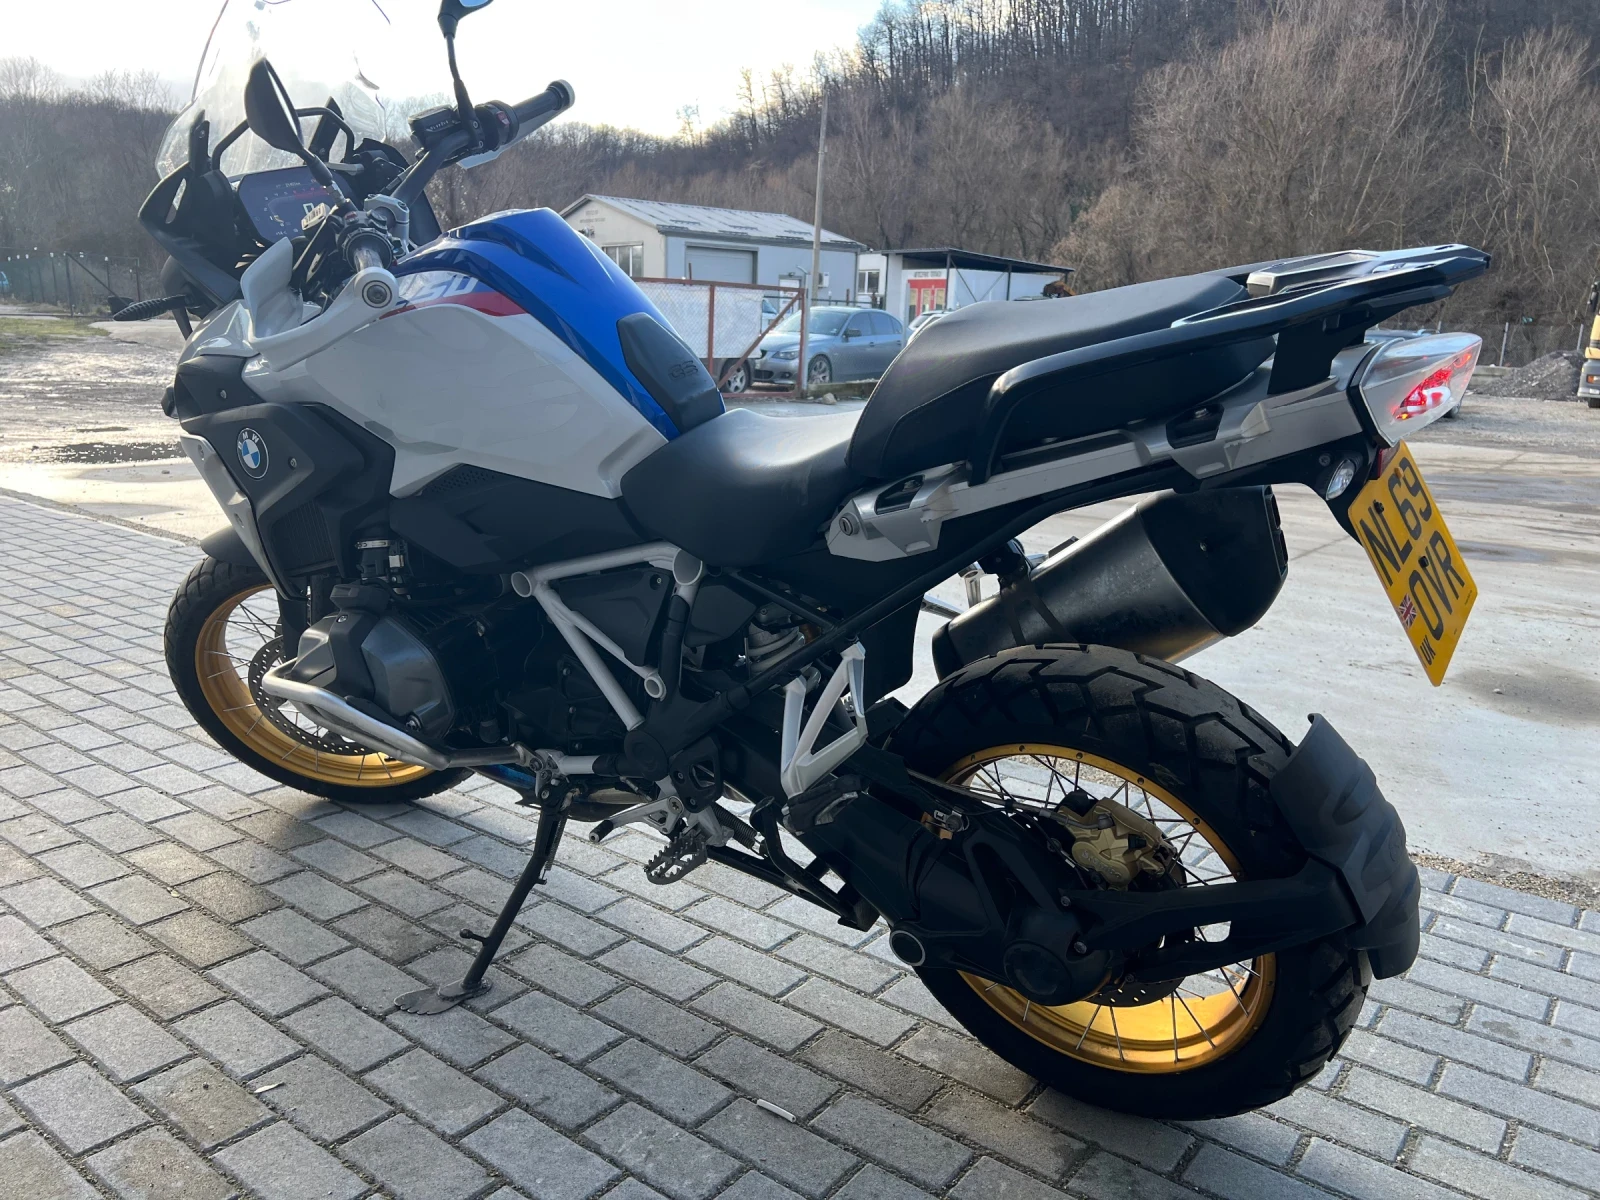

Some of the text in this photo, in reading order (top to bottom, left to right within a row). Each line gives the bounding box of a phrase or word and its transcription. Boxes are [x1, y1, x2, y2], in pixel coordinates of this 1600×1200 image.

[237, 431, 260, 450] BMW
[1409, 530, 1465, 641] OVR
[1419, 634, 1436, 665] UK
